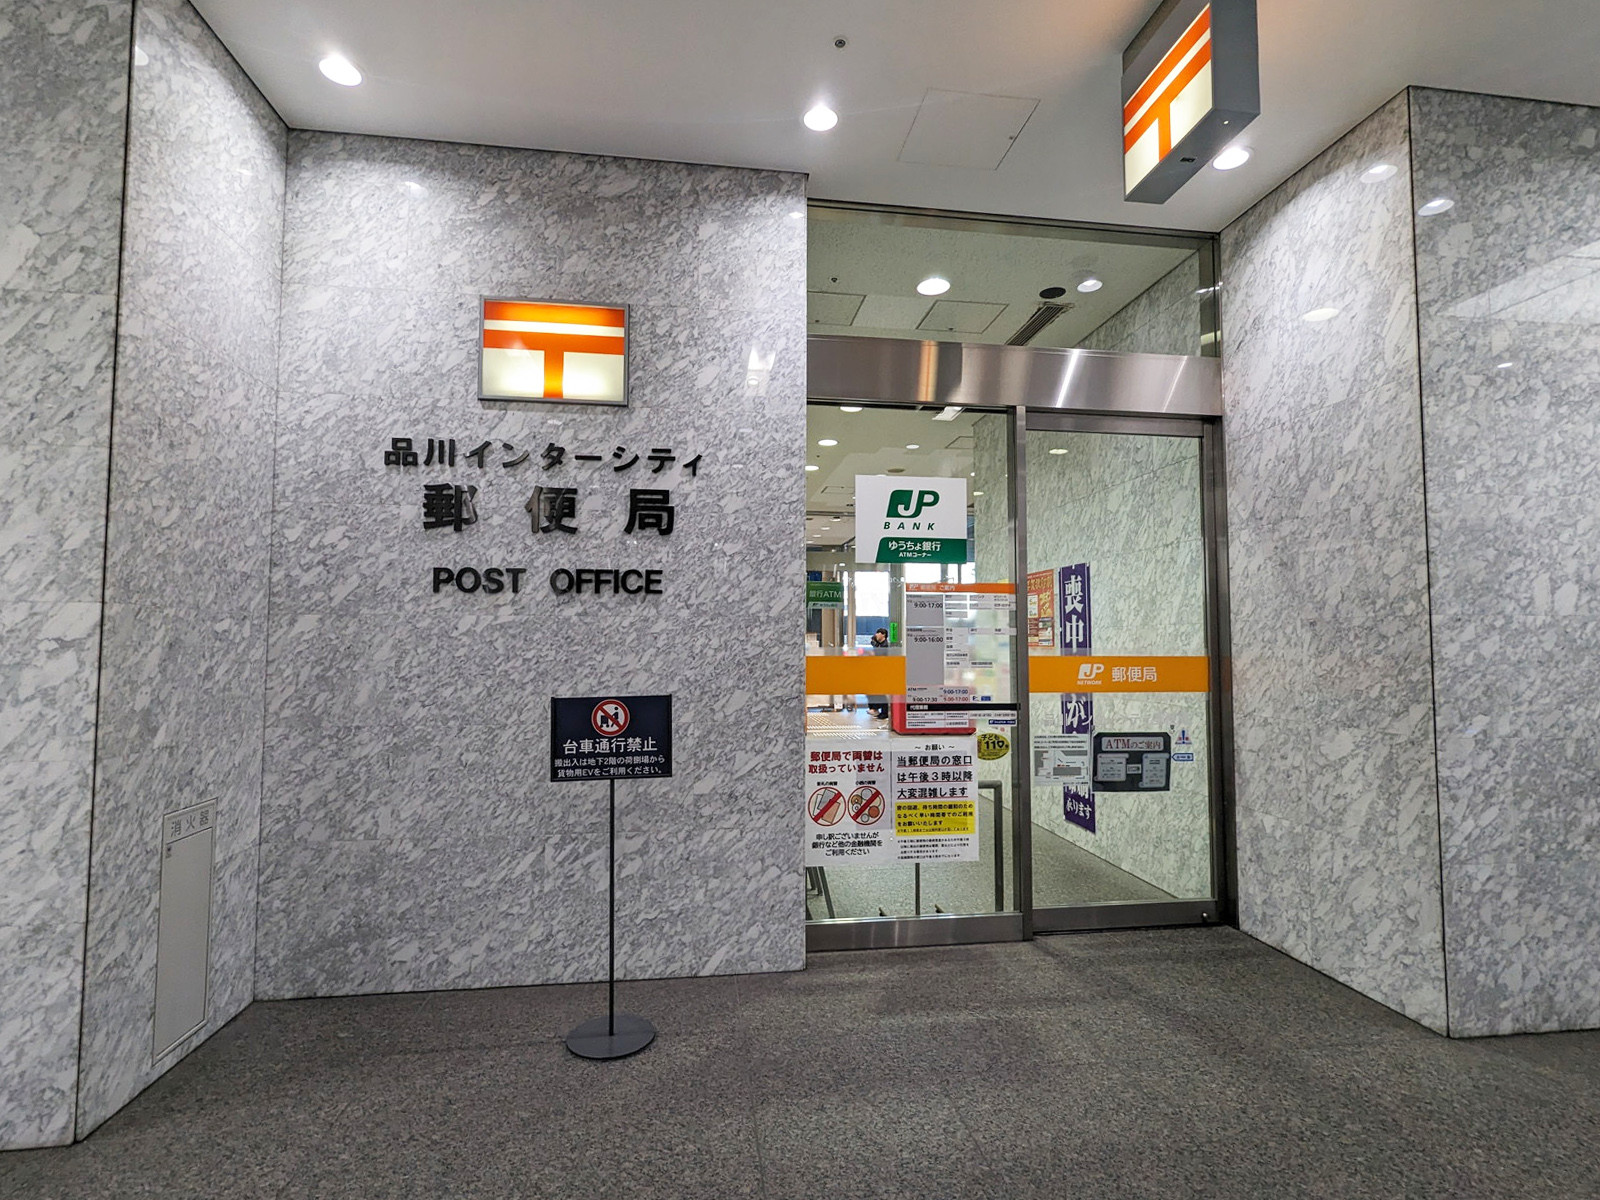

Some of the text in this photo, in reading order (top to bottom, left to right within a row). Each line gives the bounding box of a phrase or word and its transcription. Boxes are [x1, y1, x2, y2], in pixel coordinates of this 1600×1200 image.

[384, 438, 702, 476] 品川インターシティ
[423, 483, 674, 535] 郵便局
[886, 489, 940, 518] JP
[883, 522, 935, 531] BANK
[888, 541, 941, 552] ゆうちょ銀行
[433, 567, 663, 594] POST OFFICE
[1078, 664, 1104, 679] JP
[1112, 667, 1157, 682] 郵便局
[563, 736, 658, 755] 台車通行禁止
[1105, 738, 1162, 750] ATMのご案内
[810, 750, 883, 762] 郵便局で両替は
[897, 755, 972, 767] 当郵便局の窓口
[808, 763, 885, 774] 取扱っていません
[897, 770, 973, 783] は午後3時以降
[897, 787, 968, 799] 大変混雑します
[170, 809, 209, 837] 消火器
[816, 831, 880, 841] 申し訳ございませんが
[812, 840, 883, 849] 銀行など他の金融機関を
[825, 848, 870, 856] ご利用ください
